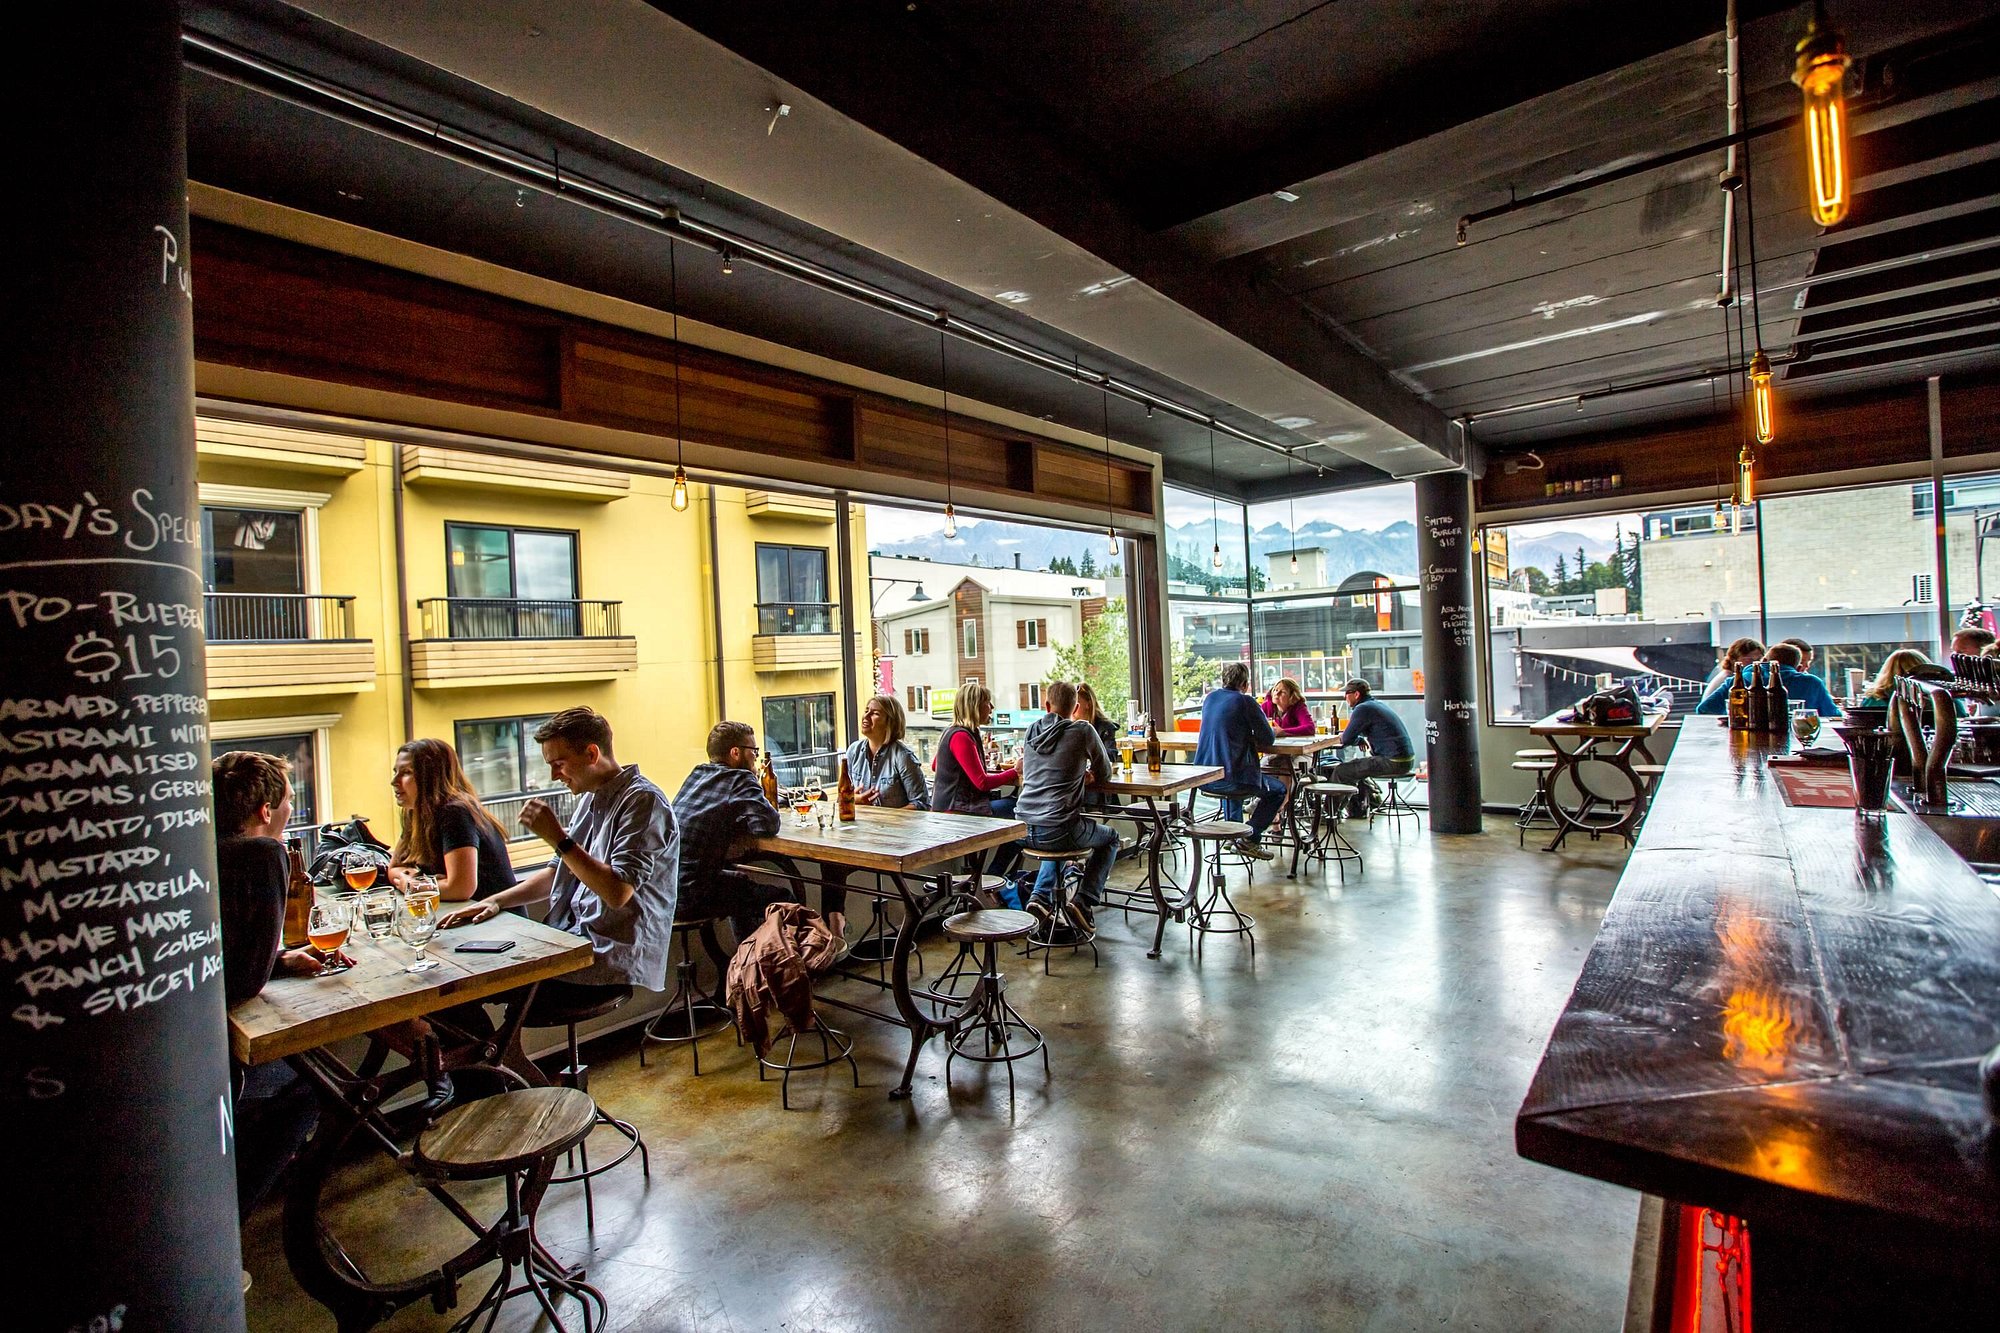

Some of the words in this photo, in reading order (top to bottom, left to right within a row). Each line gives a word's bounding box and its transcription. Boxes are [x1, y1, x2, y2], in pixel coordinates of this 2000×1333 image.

[66, 631, 181, 683] $15
[171, 724, 207, 744] WITH
[0, 922, 117, 963] HOME
[126, 908, 192, 942] MADE
[11, 1003, 67, 1031] &
[82, 962, 195, 1016] SPICEY
[16, 945, 146, 998] RANCH
